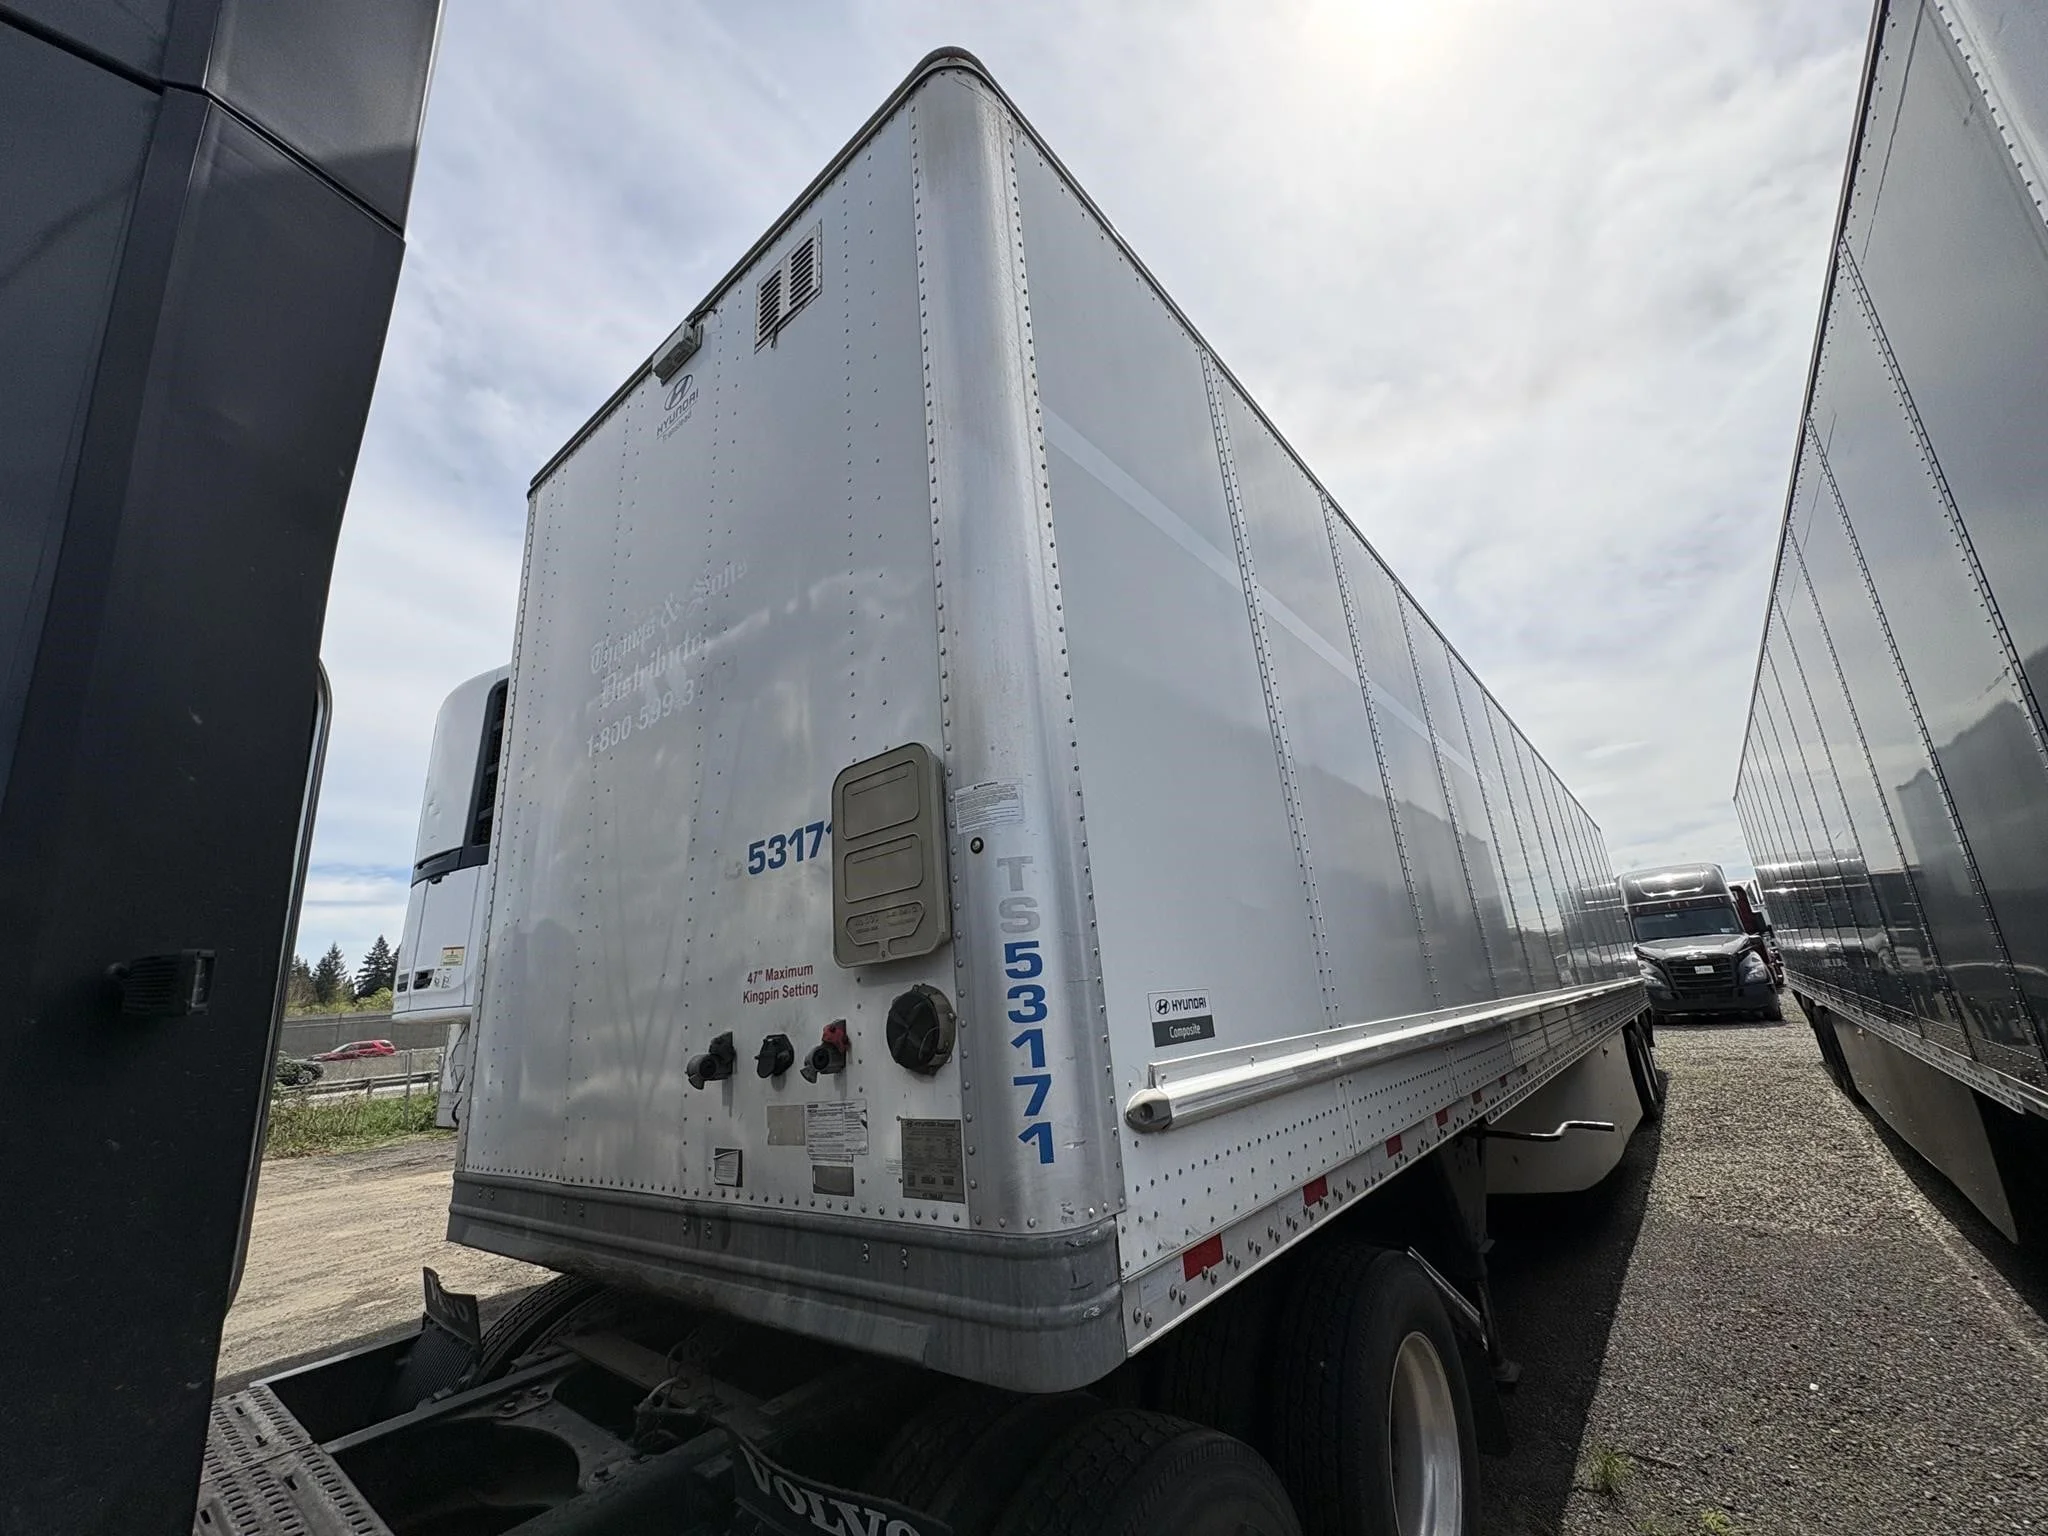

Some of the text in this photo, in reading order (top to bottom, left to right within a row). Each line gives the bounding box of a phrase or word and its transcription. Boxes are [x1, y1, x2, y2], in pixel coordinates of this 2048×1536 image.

[656, 386, 699, 437] HYUNDAI
[747, 821, 832, 875] 5317
[765, 964, 814, 982] Maximum
[743, 982, 819, 1005] Kingpin Setting
[1171, 997, 1207, 1012] HYUNDAI
[1169, 1023, 1201, 1039] Composite
